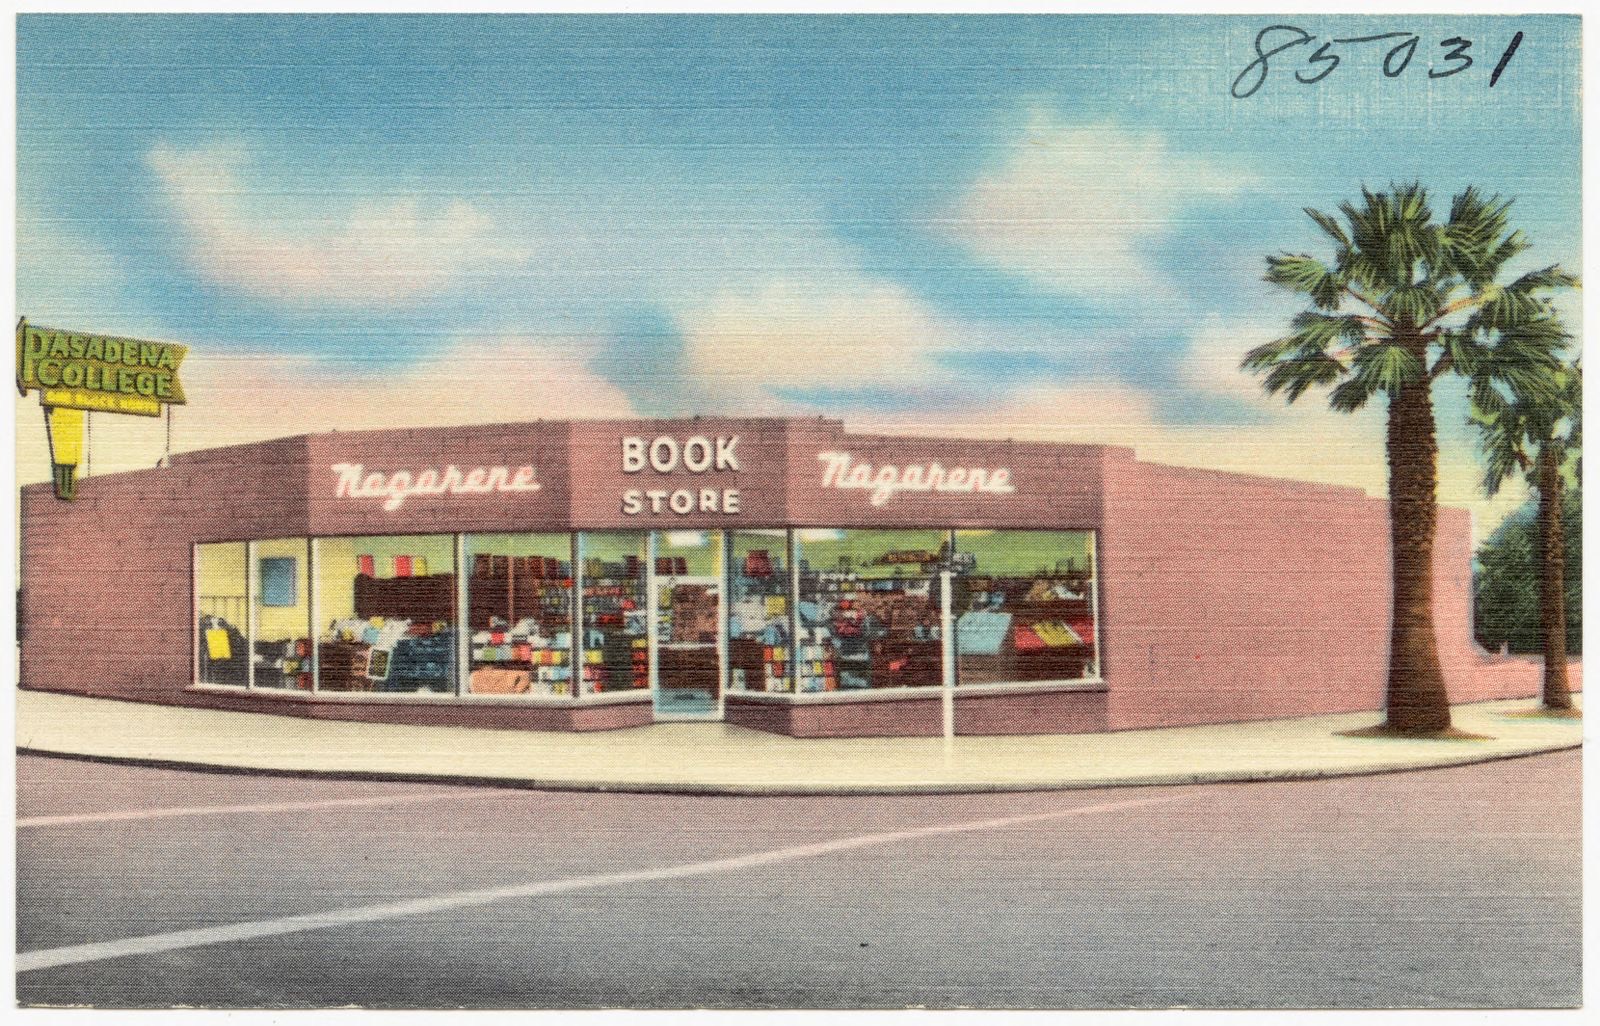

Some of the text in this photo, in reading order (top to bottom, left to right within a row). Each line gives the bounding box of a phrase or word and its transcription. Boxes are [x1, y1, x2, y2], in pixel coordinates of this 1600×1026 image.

[1231, 25, 1523, 98] 85031
[22, 326, 175, 383] PASADENA
[37, 359, 173, 397] COLLEGE
[621, 435, 740, 474] BOOK
[622, 489, 741, 515] STORE
